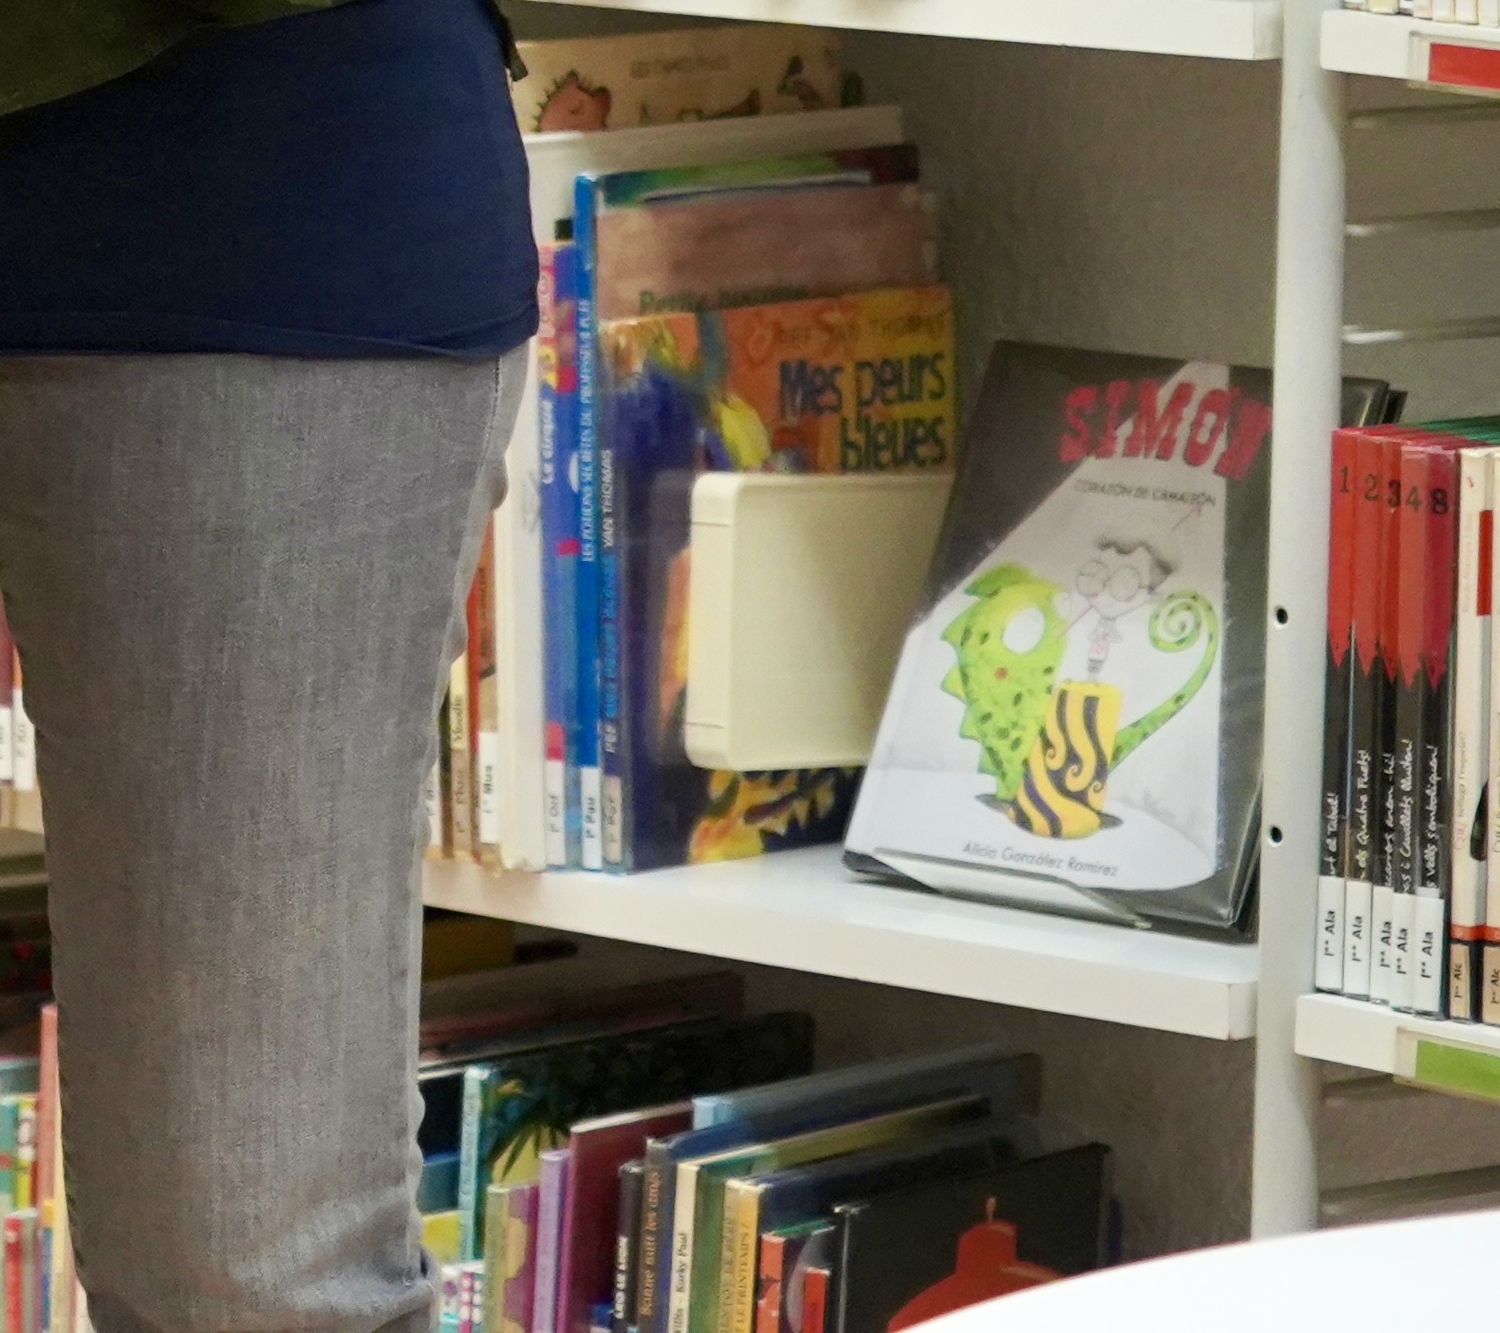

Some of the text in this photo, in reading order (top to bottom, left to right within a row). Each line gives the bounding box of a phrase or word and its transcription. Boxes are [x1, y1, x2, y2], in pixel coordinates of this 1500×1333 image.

[779, 352, 947, 422] Mes peurs
[839, 414, 947, 472] bleues
[603, 449, 614, 515] THOMAS
[1338, 465, 1350, 494] 1
[1363, 473, 1380, 502] 2
[1387, 479, 1401, 508] 3
[1404, 485, 1423, 513] 4
[1430, 488, 1449, 516] 8
[962, 840, 1118, 878] Alicia González Ramírez
[647, 1171, 660, 1230] les amis
[673, 1231, 688, 1294] Korky Paul
